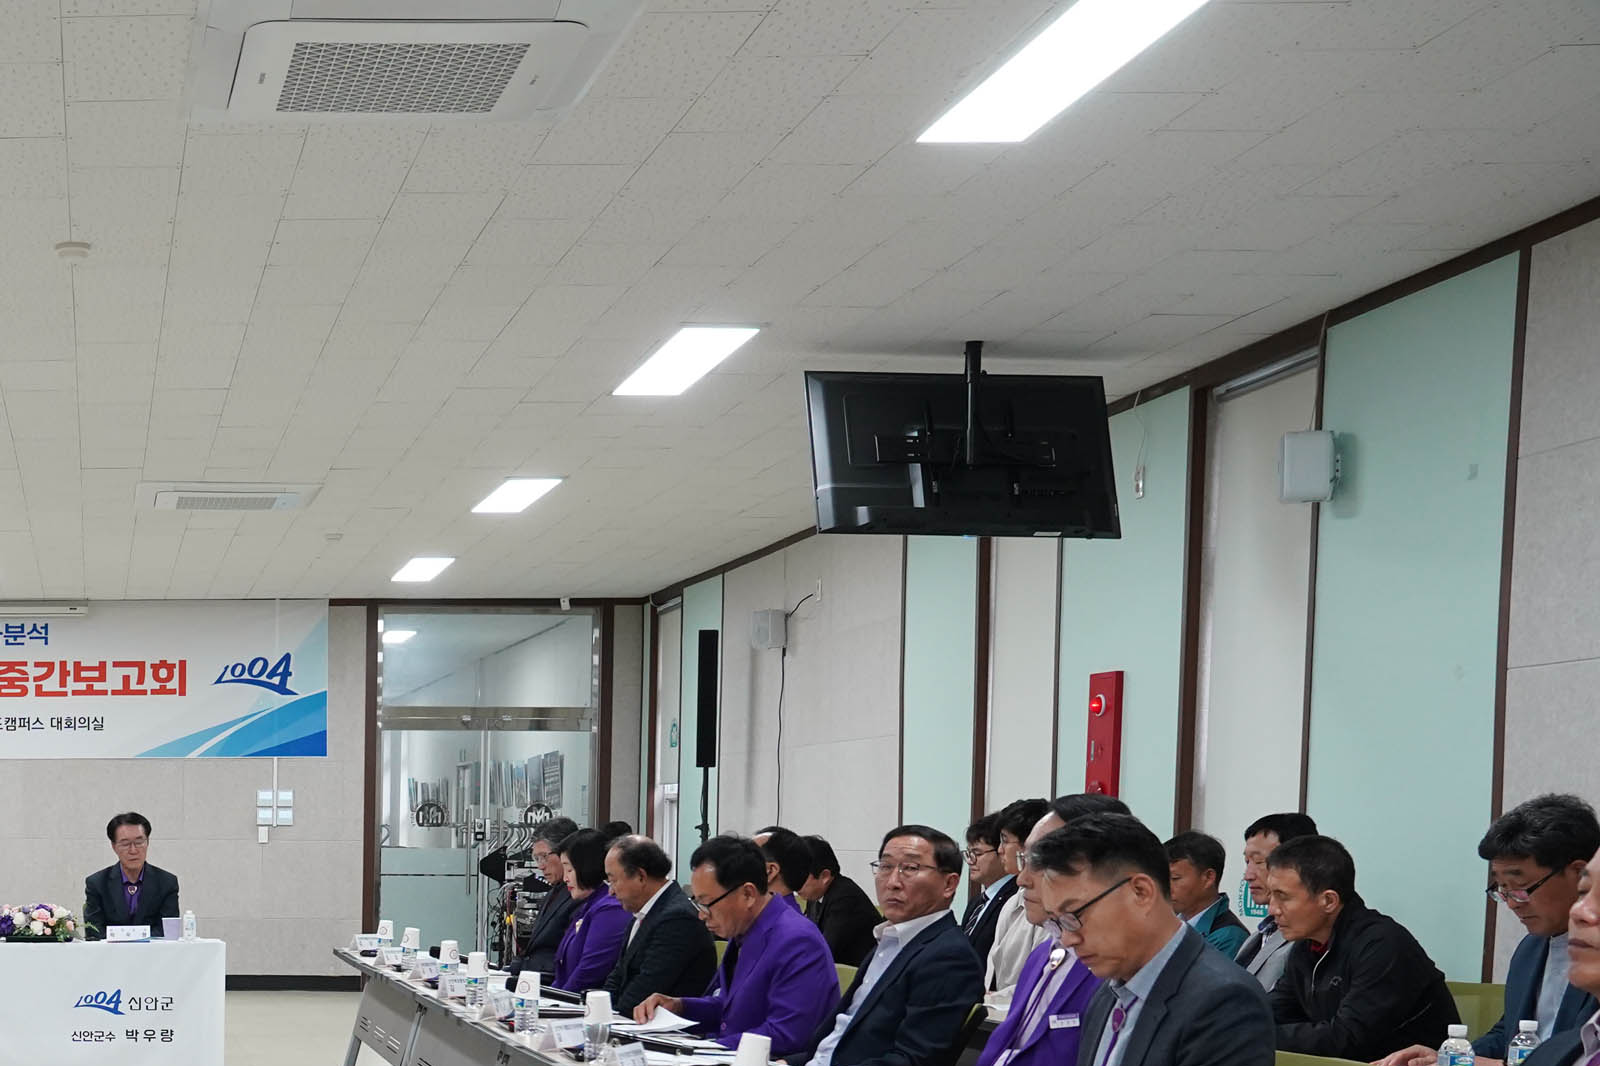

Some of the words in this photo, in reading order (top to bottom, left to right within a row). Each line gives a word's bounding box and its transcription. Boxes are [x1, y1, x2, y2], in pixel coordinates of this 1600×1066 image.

[50, 716, 104, 731] 대회의실
[128, 996, 174, 1011] 신안군
[71, 1030, 116, 1042] 신안군수
